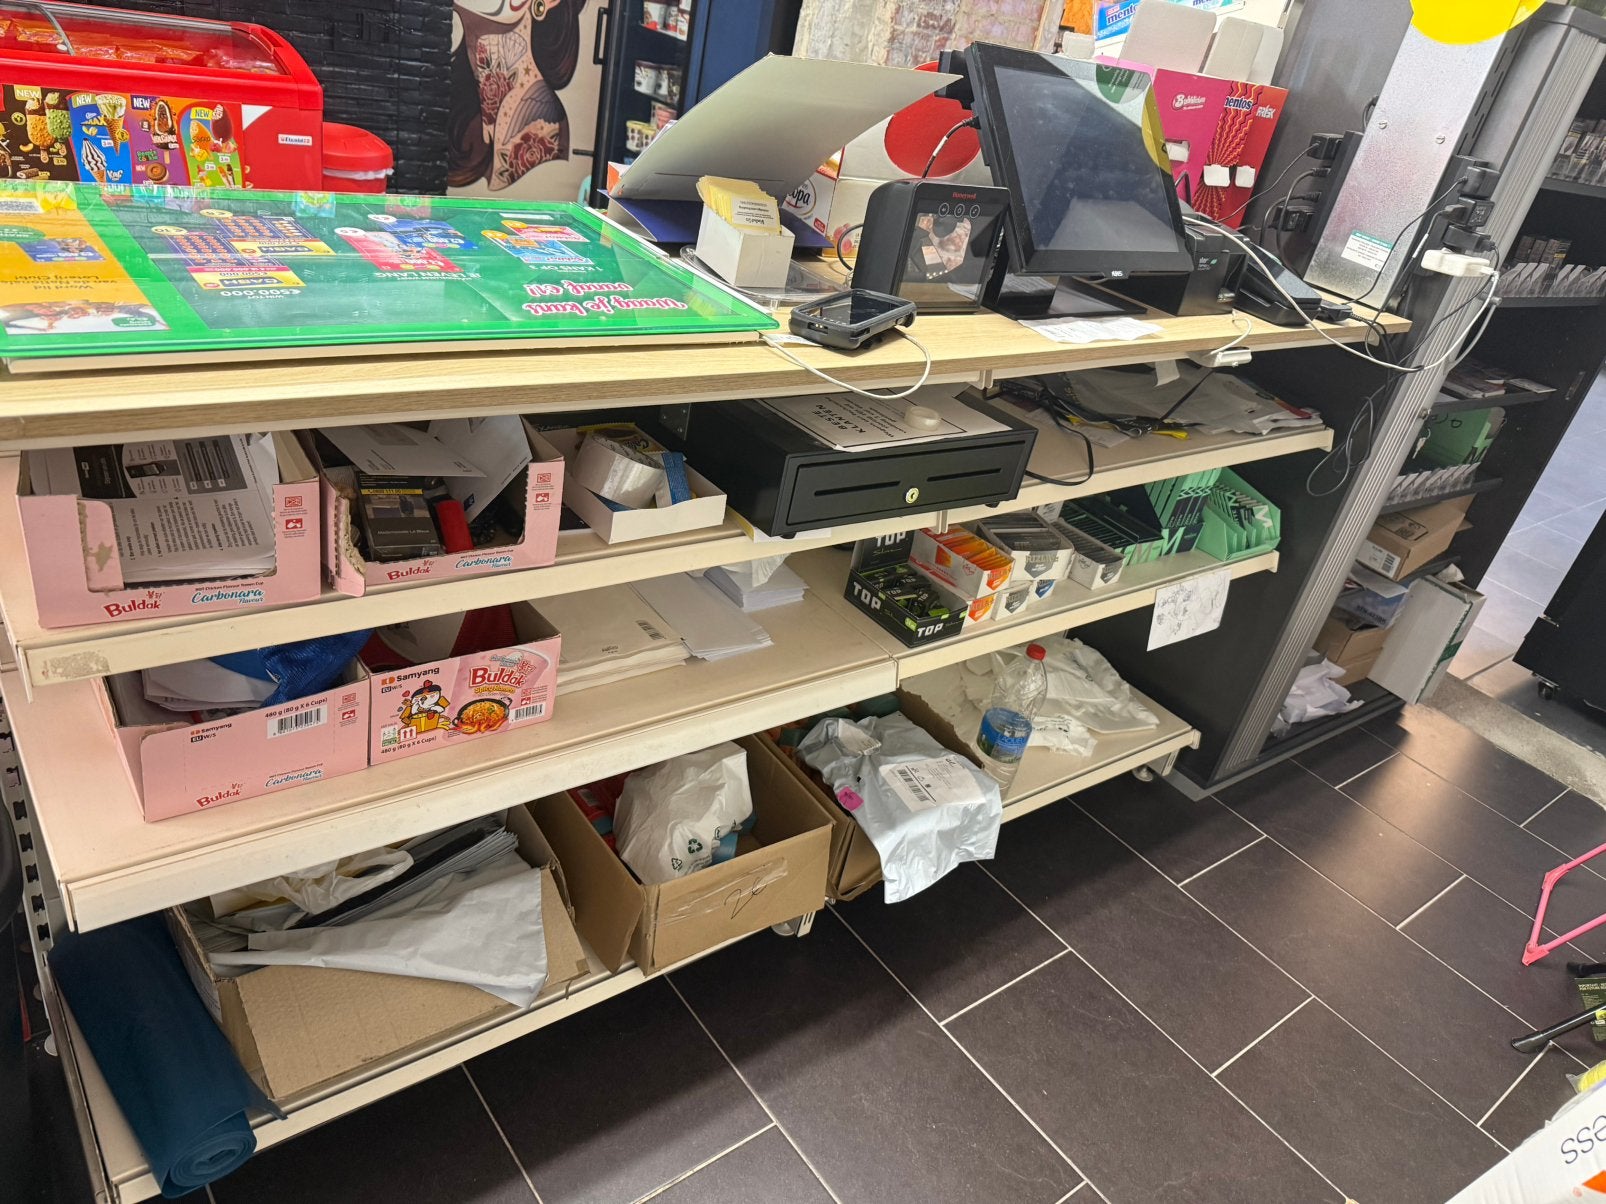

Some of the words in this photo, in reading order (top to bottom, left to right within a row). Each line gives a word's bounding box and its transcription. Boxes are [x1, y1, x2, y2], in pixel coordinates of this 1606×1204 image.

[16, 89, 40, 98] NEW
[76, 95, 92, 104] NEW
[133, 98, 150, 109] NEW
[562, 281, 632, 295] vanaf
[524, 302, 587, 315] kans
[584, 297, 613, 313] je
[613, 297, 688, 310] Waag
[812, 410, 848, 429] BESTE
[815, 404, 866, 433] KLANTEN
[455, 554, 512, 569] Carbonara
[386, 565, 431, 581] Buldak
[191, 589, 264, 604] Carbonara
[853, 581, 882, 610] TOP
[103, 600, 160, 618] Buldak
[917, 623, 944, 637] TOP
[396, 667, 440, 682] Samyang
[471, 667, 525, 687] Buldak
[310, 698, 328, 707] Cups)
[201, 722, 232, 733] Samyang
[421, 736, 437, 744] Cups)
[265, 769, 322, 787] Carbonara
[196, 789, 241, 807] Buldak
